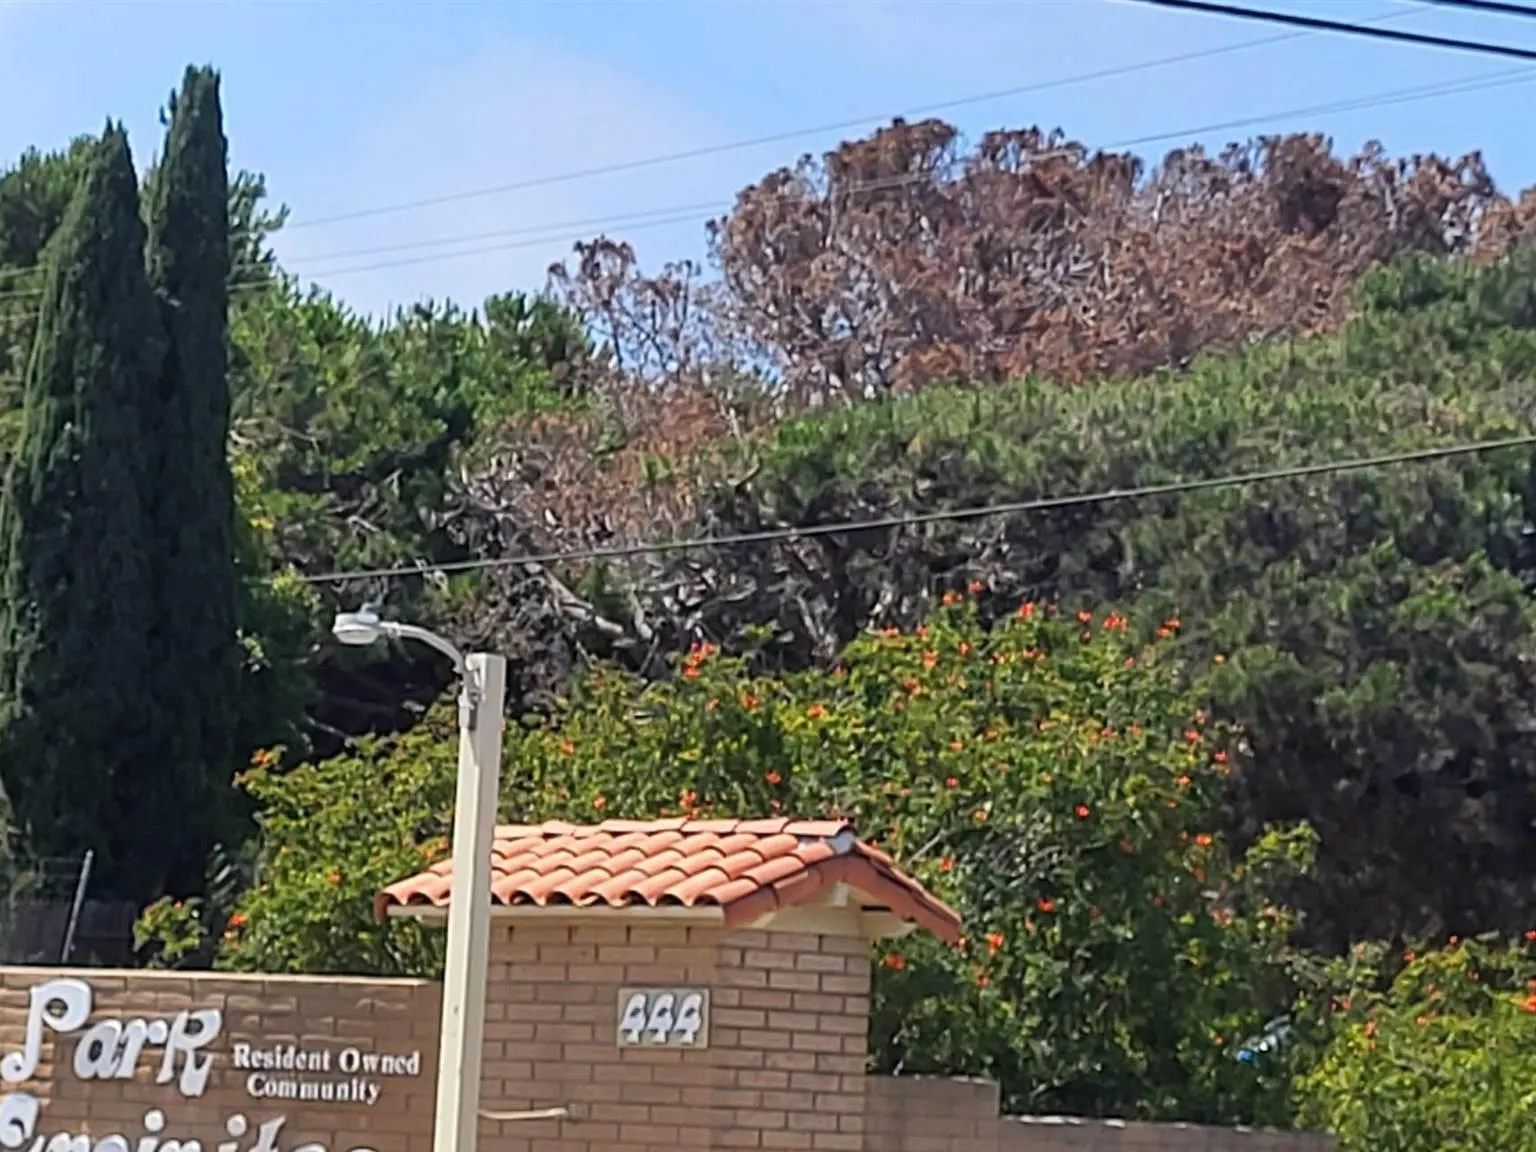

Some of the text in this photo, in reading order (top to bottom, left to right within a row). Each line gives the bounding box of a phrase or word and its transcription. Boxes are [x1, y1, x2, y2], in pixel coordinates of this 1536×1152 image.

[619, 992, 703, 1044] 444
[233, 1043, 421, 1075] Resident Owned
[246, 1072, 381, 1105] Community
